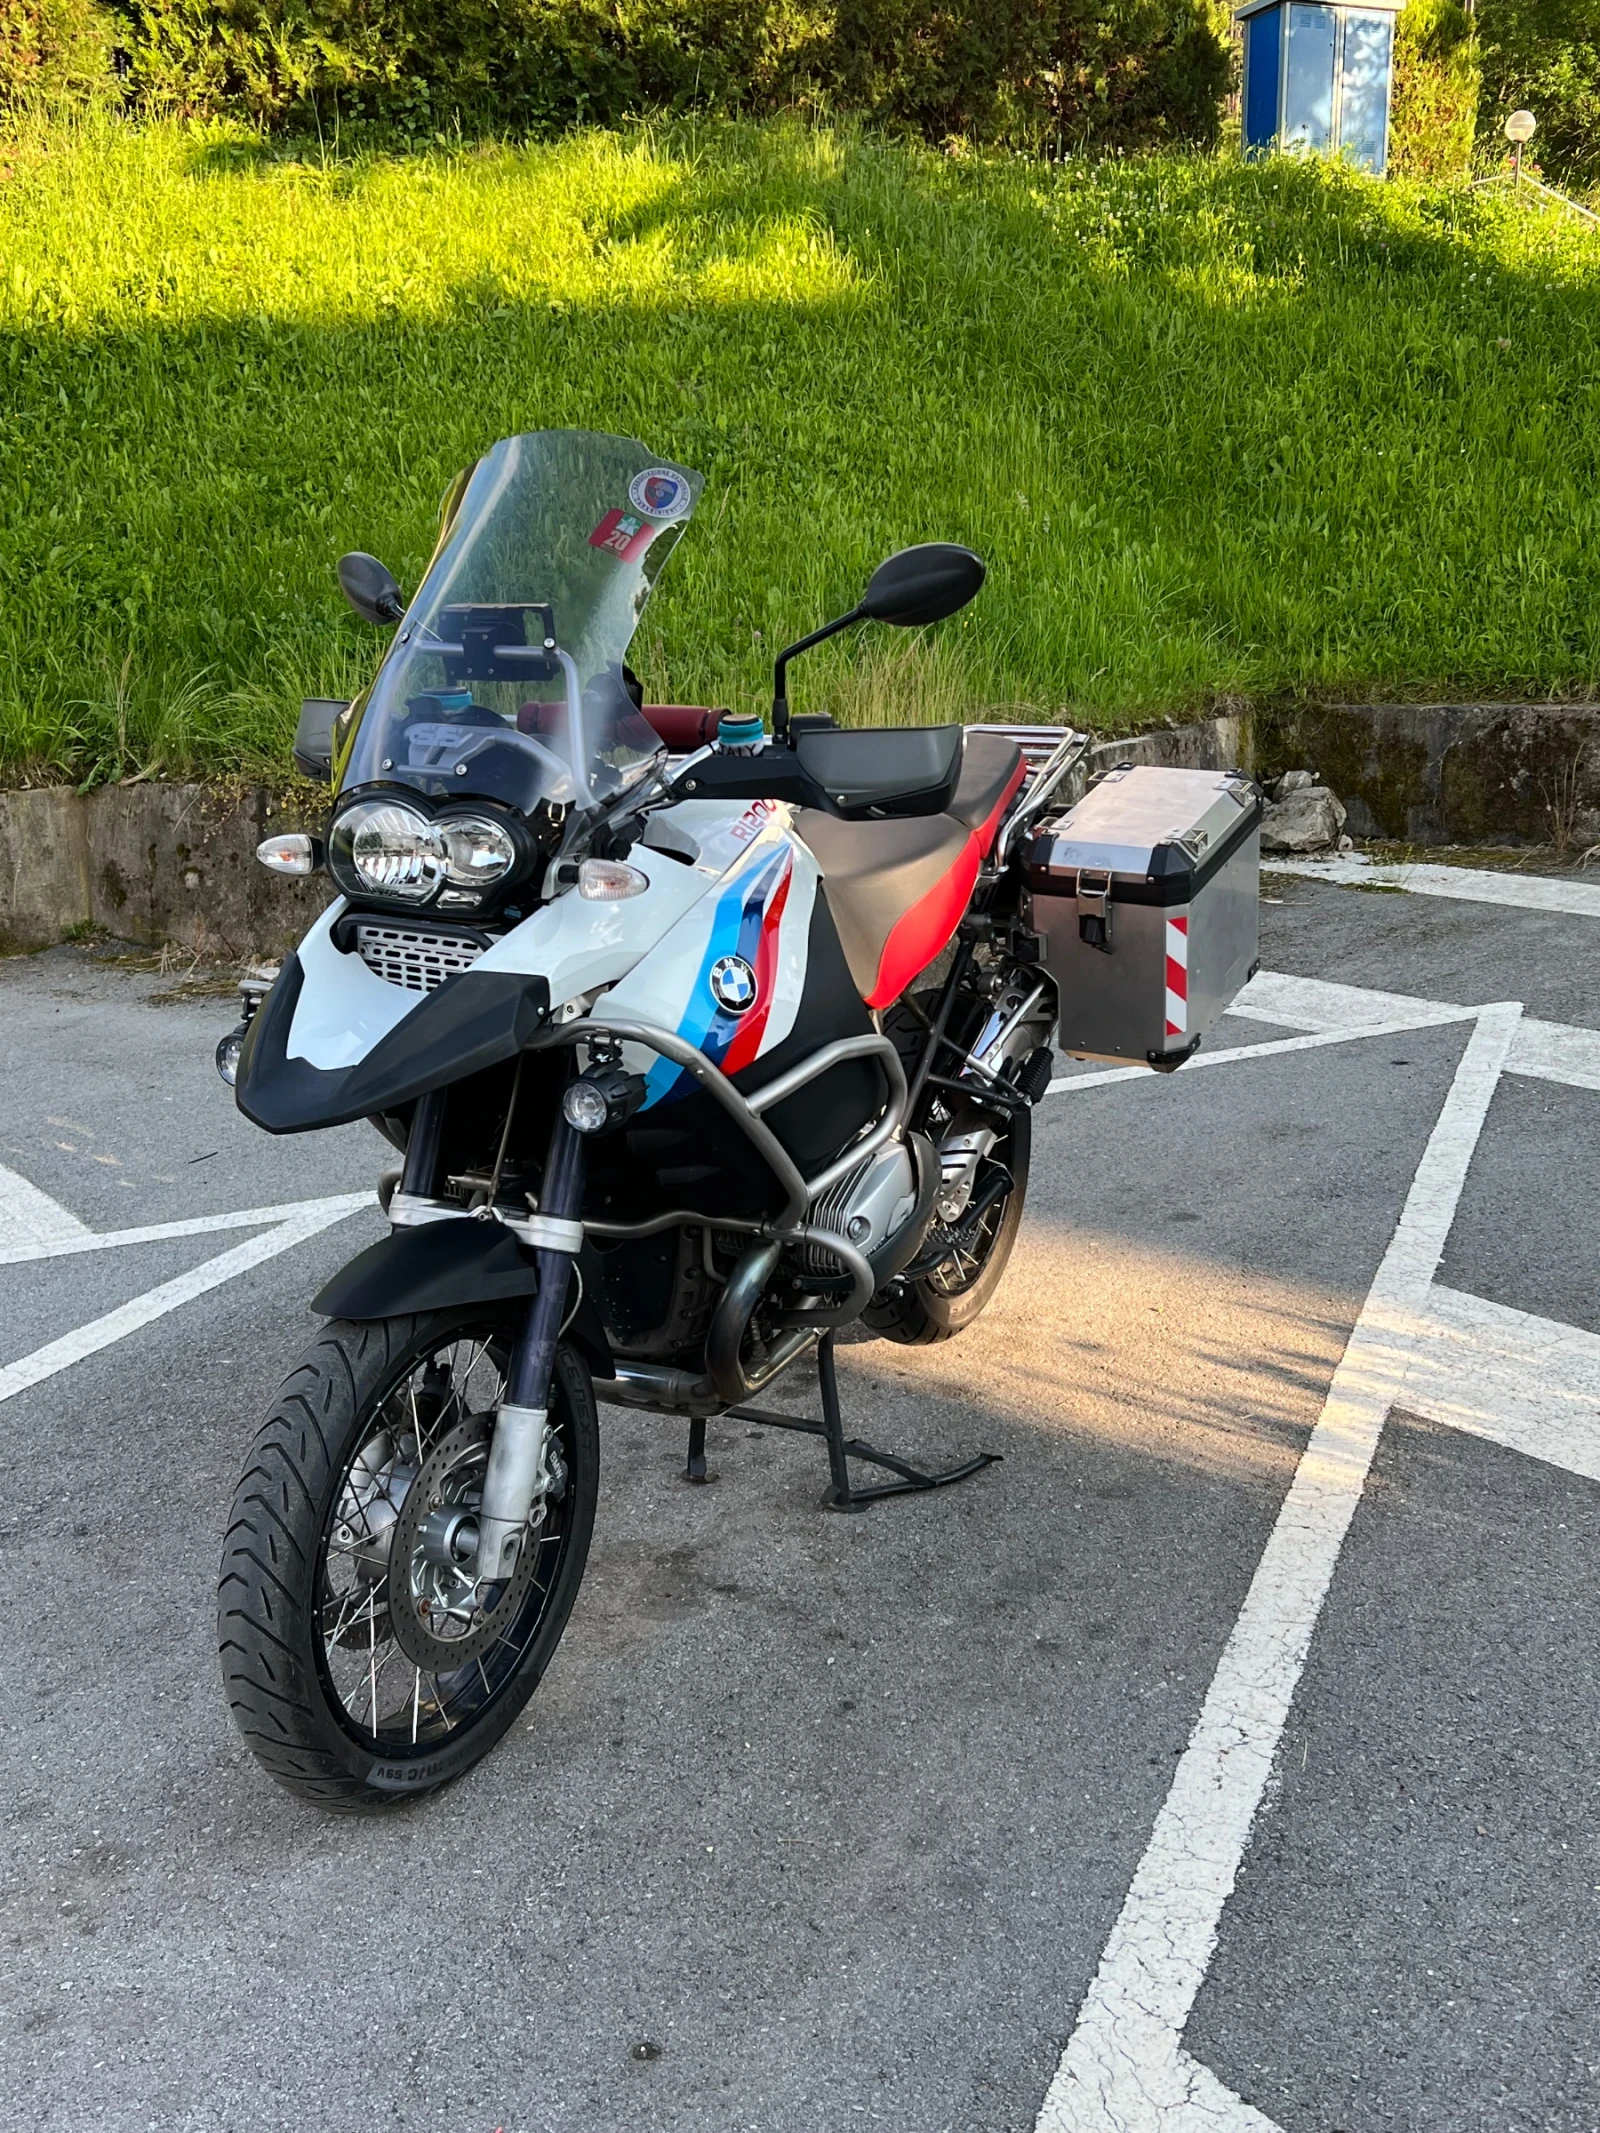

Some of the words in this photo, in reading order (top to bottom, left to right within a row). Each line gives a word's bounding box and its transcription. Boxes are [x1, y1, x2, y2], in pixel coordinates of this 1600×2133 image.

[603, 530, 631, 551] 20
[713, 958, 749, 978] BMW
[549, 1450, 564, 1480] BMW
[376, 1767, 403, 1780] 59V
